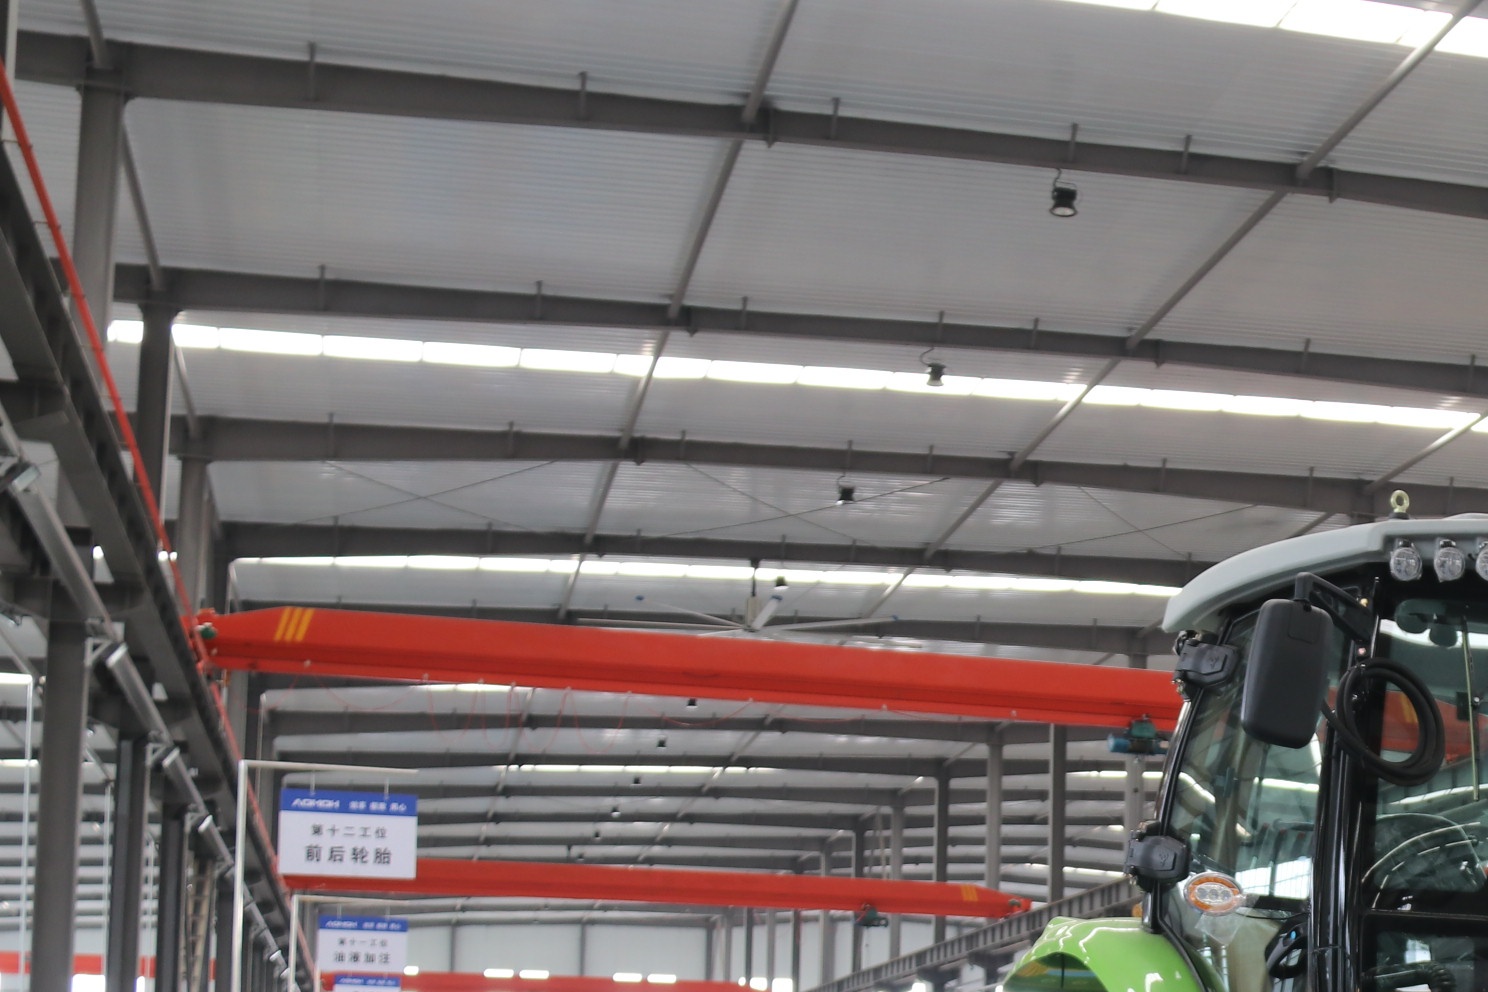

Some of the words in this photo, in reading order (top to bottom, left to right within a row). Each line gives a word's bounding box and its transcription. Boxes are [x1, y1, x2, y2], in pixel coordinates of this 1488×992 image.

[311, 824, 387, 839] 第十二工位
[304, 844, 392, 865] 前后轮胎
